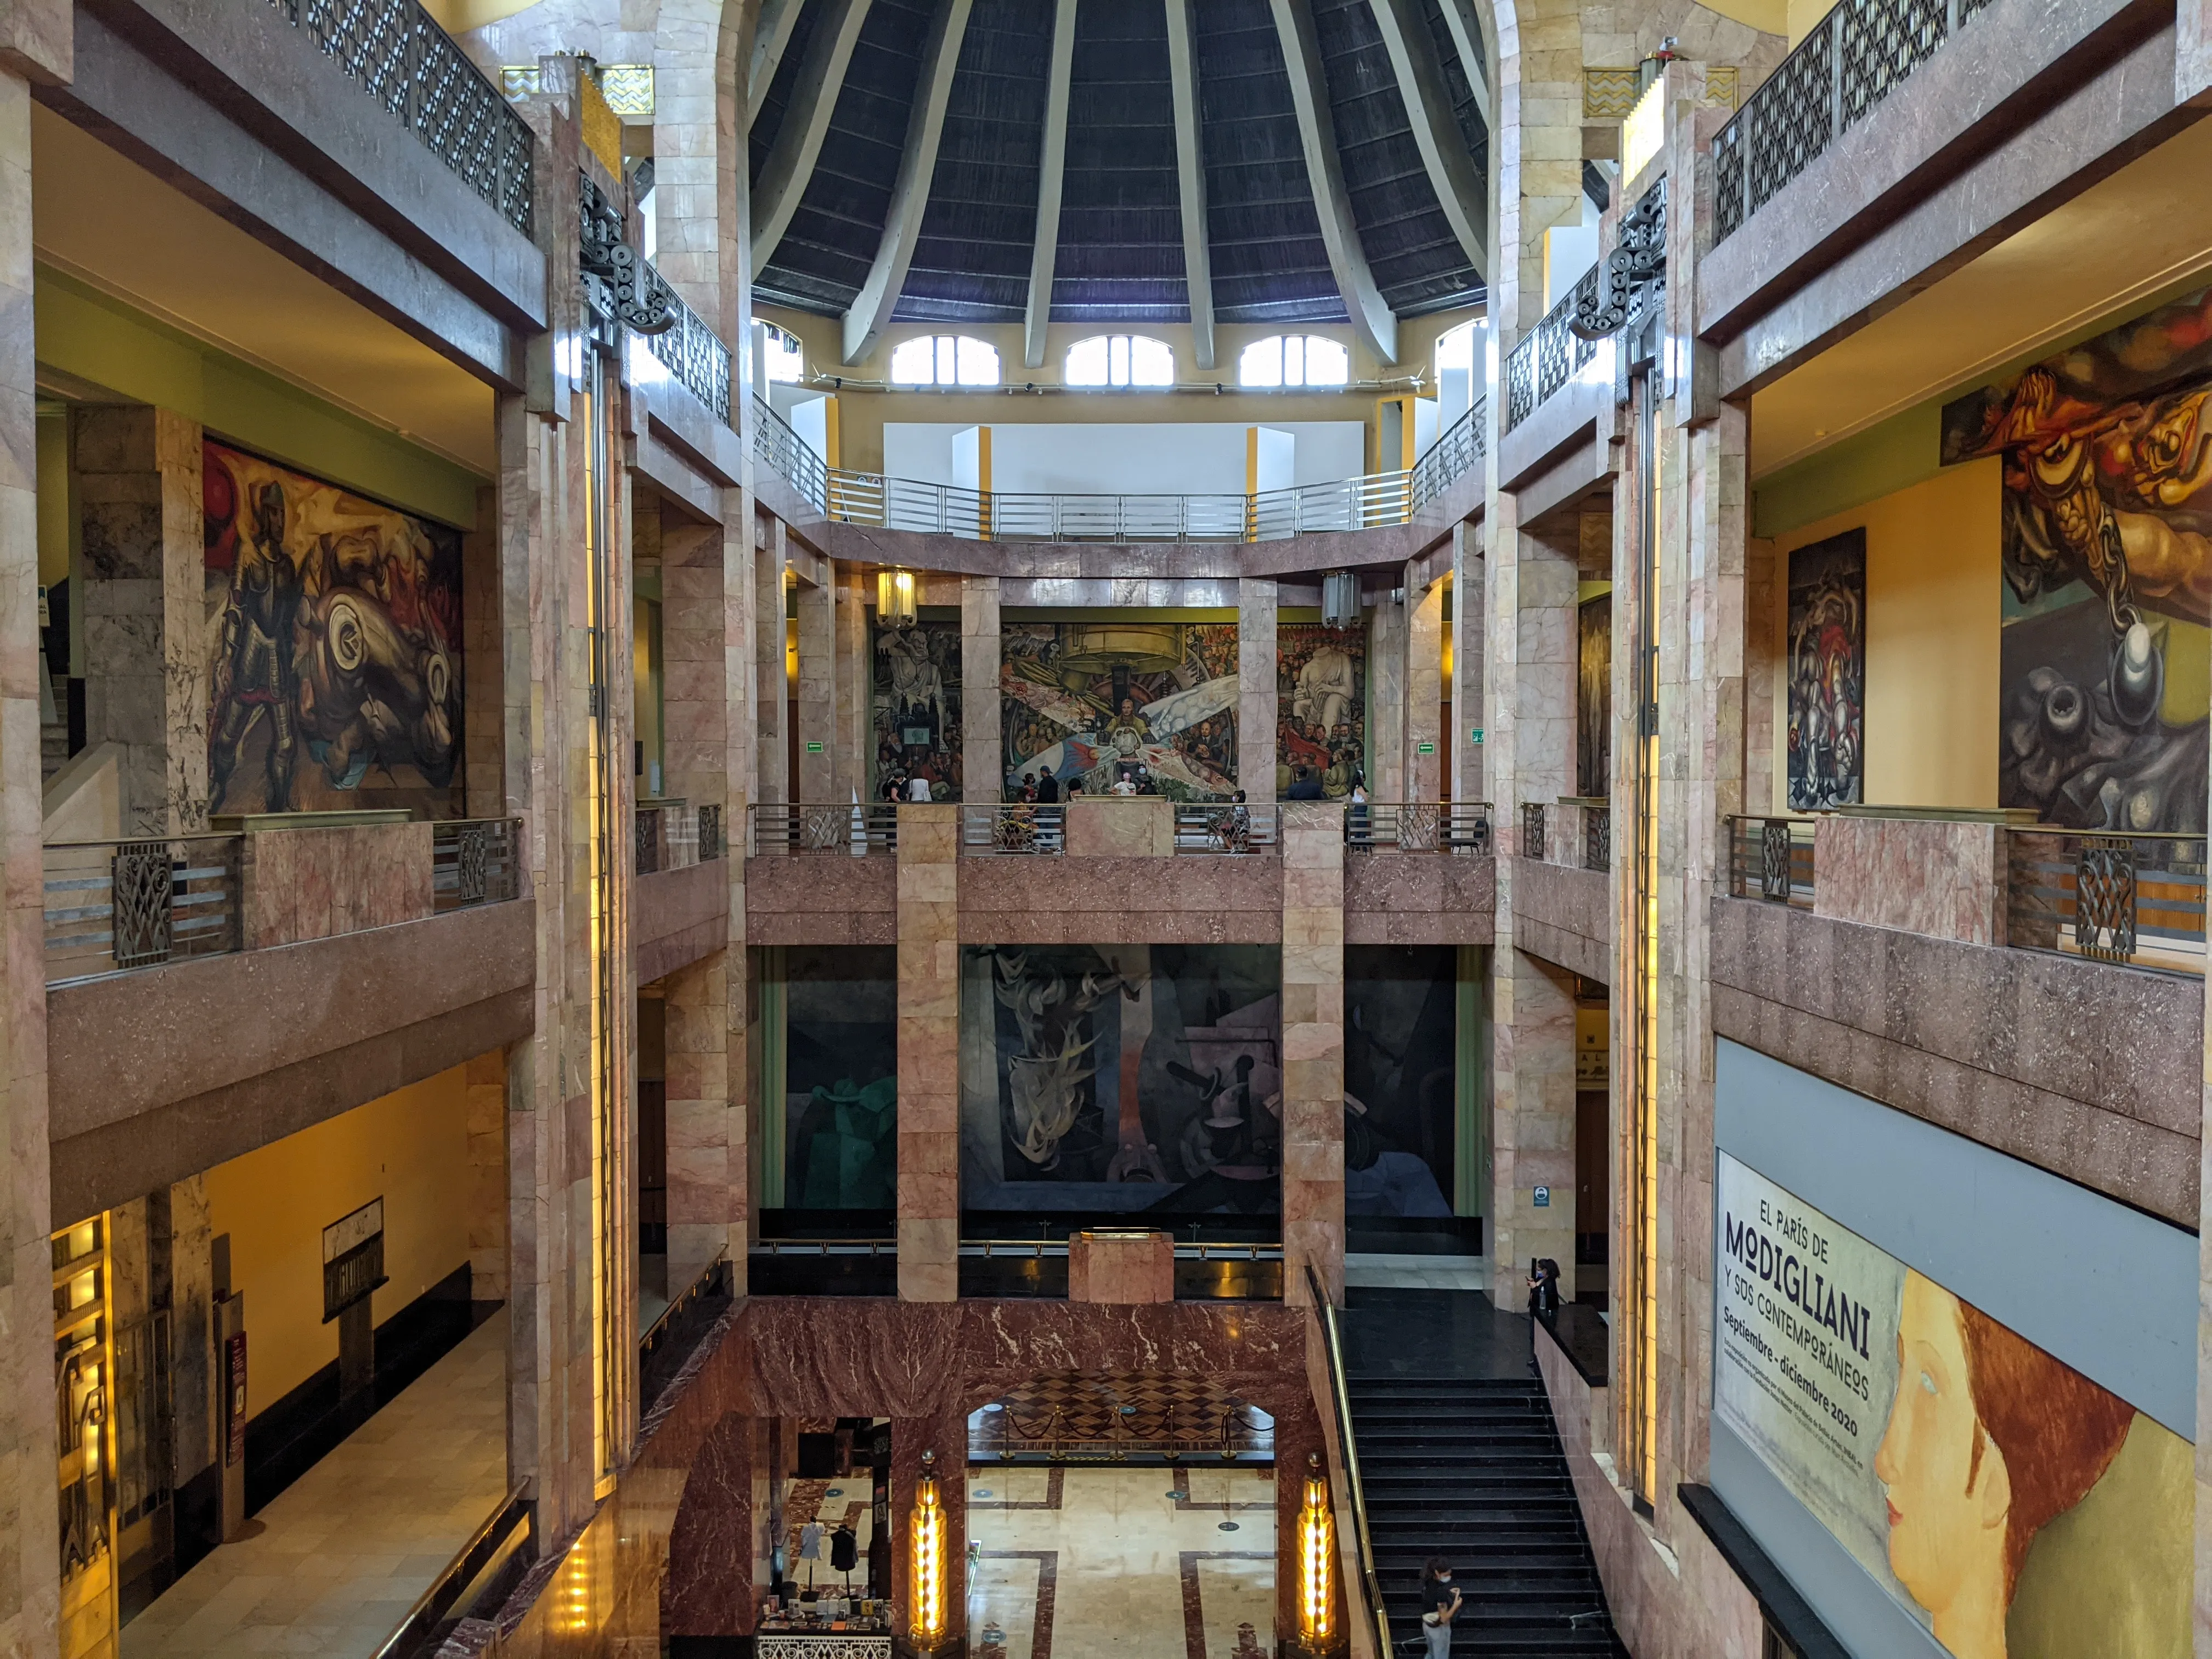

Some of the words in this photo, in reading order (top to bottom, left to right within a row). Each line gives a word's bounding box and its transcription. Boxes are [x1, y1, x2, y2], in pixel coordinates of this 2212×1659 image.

[1726, 1211, 1870, 1361] MODIGLIANI
[1760, 1199, 1773, 1227] EL
[1777, 1209, 1808, 1250] PARÍS
[1813, 1233, 1829, 1265] DE
[1724, 1305, 1773, 1363] Septiembre
[1780, 1355, 1829, 1413] diciembre
[1831, 1402, 1858, 1437] 2020
[1725, 1265, 1732, 1287] Y
[1735, 1274, 1754, 1306] SUS
[1757, 1293, 1869, 1401] CONTEMPORÁNEOS
